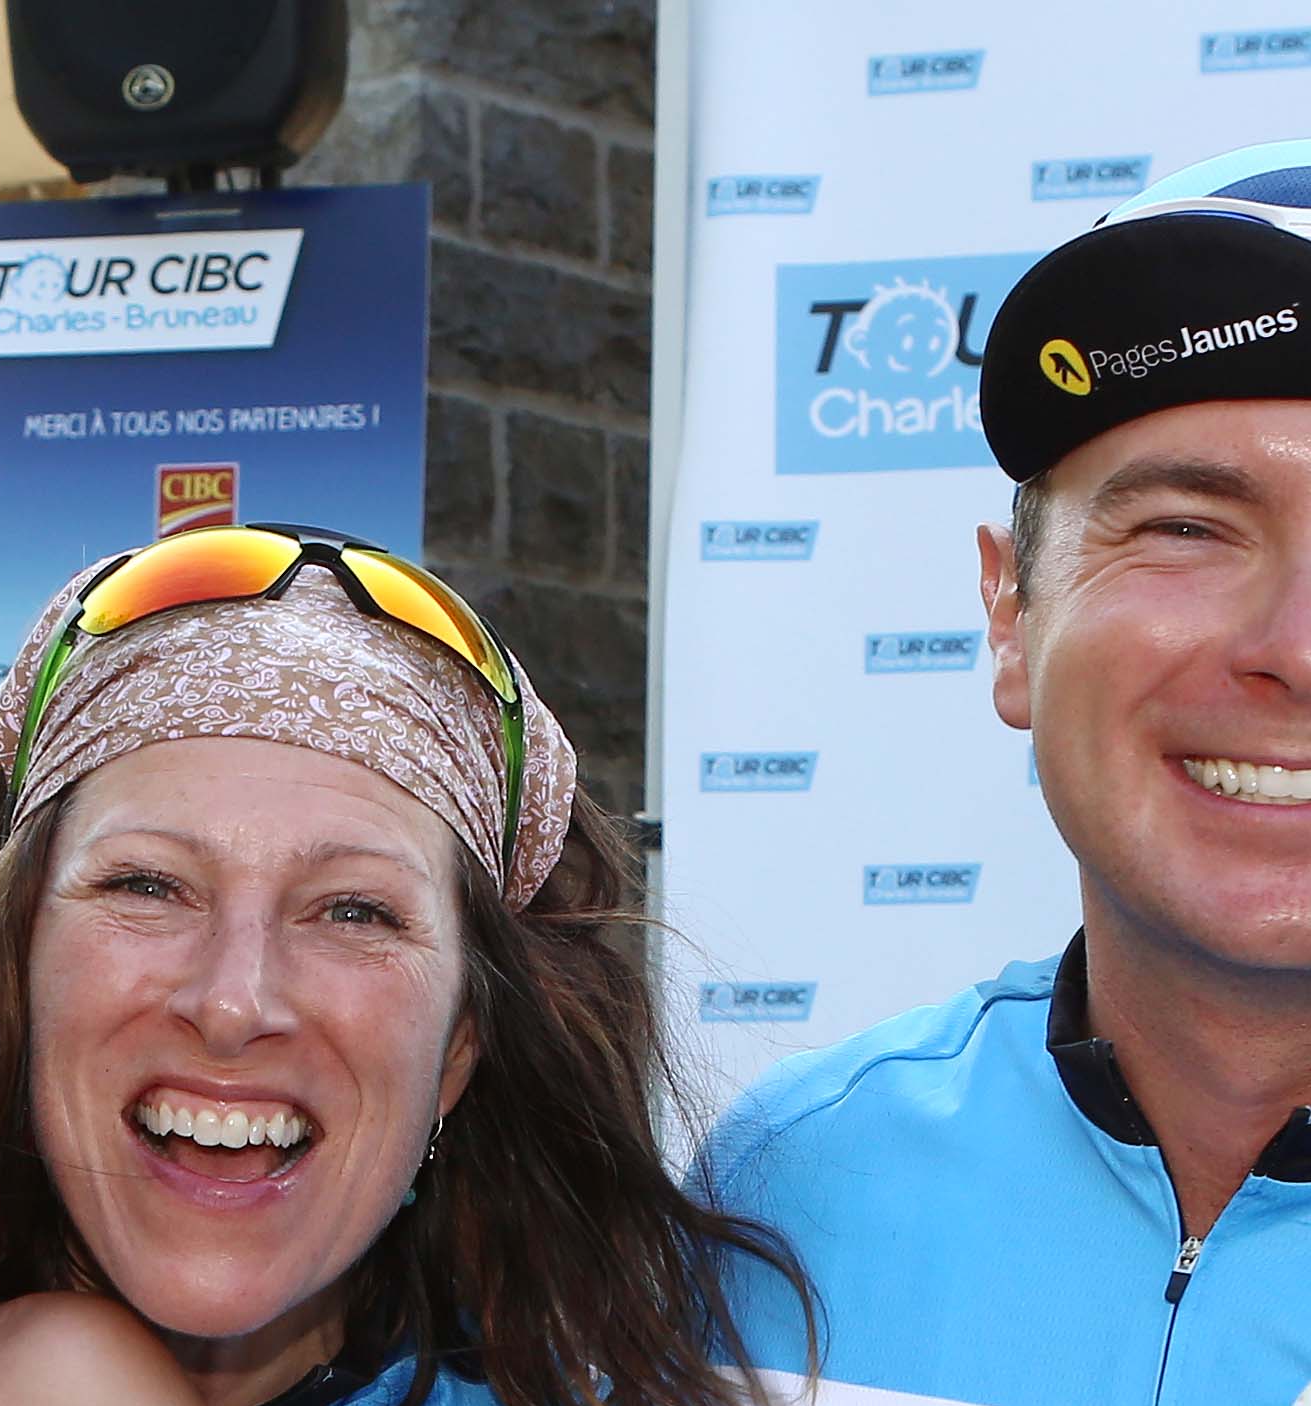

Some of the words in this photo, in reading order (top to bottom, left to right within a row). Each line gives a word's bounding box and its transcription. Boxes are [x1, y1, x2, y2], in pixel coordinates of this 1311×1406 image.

[150, 251, 269, 295] CIBC
[24, 413, 86, 438] MERCI
[111, 409, 171, 437] TOUS
[177, 408, 224, 433] NOS
[229, 404, 366, 432] PARTENAIRES
[162, 472, 232, 501] CIBC
